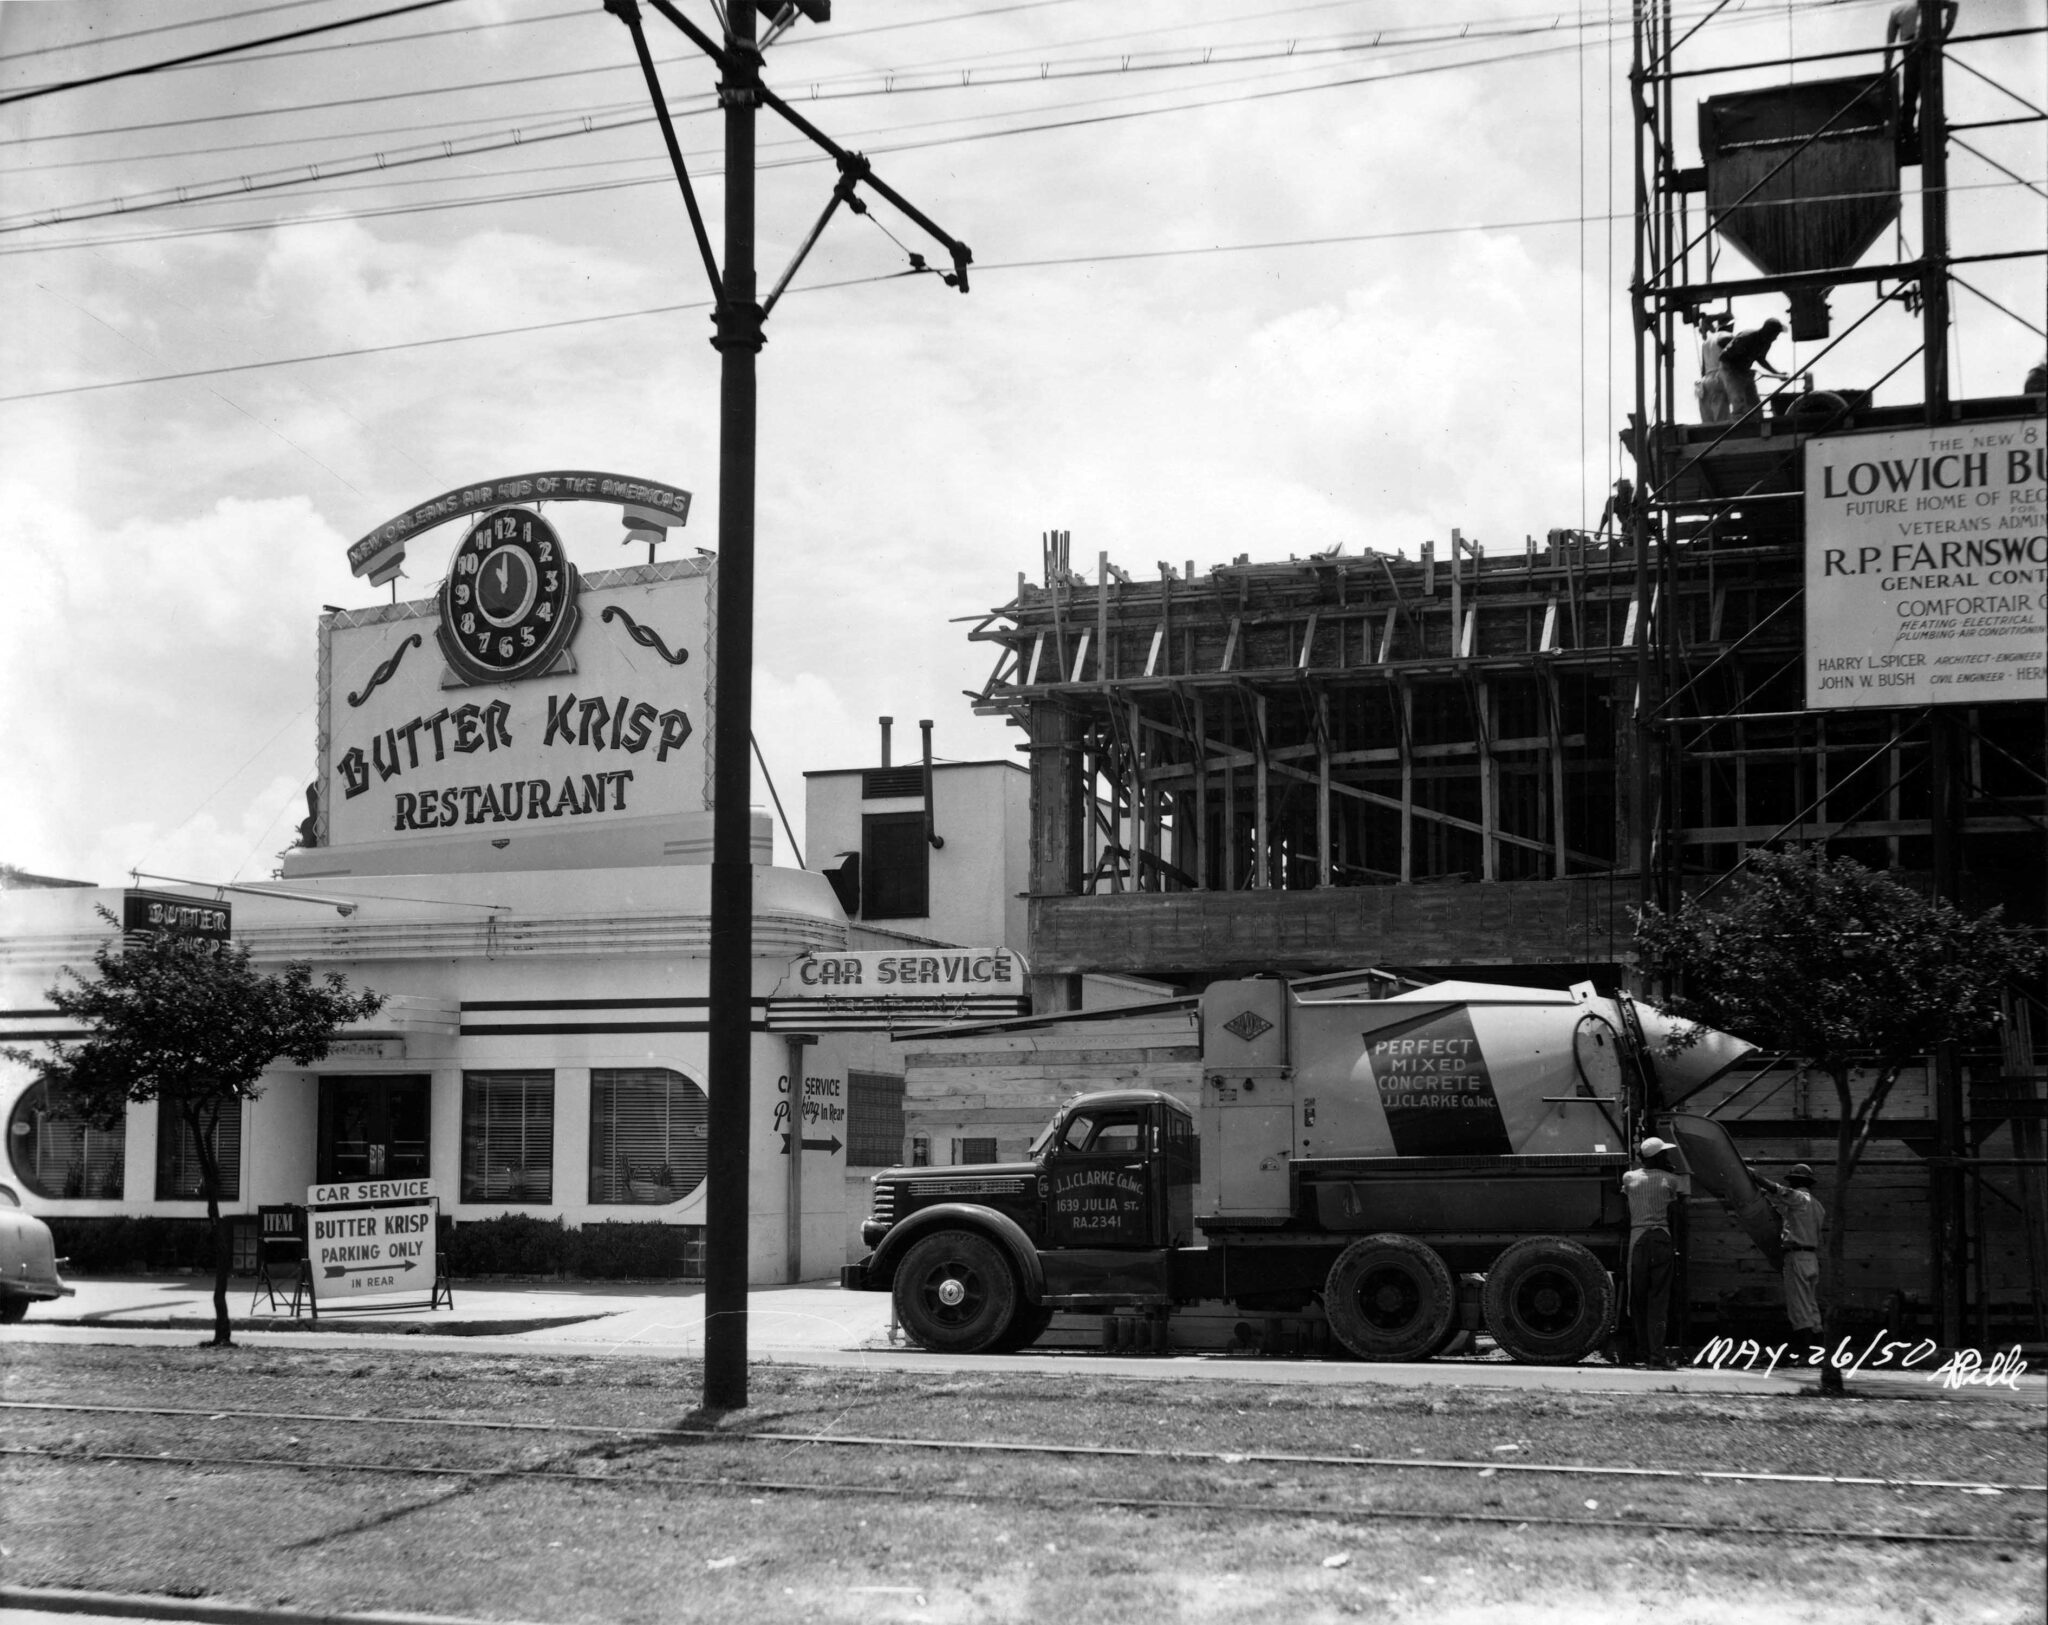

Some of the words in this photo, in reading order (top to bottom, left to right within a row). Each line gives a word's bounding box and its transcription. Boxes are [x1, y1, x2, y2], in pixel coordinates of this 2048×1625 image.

[1929, 438, 1964, 452] THE
[1973, 433, 2014, 449] NEW
[2023, 426, 2039, 444] 8
[1823, 451, 1989, 499] LOWICH
[1846, 497, 1908, 517] FUTURE
[1916, 493, 1967, 512] HOME
[1975, 490, 2000, 507] OF
[350, 532, 382, 564] NEW
[385, 495, 459, 543] ORLEANS
[463, 486, 493, 507] AIR
[536, 477, 560, 493] OF
[564, 477, 597, 493] THE
[601, 478, 686, 513] AMERICAS
[494, 516, 517, 540] 12
[1898, 516, 1991, 536] VETERANS
[475, 528, 492, 550] 11
[523, 521, 532, 543] 1
[537, 541, 553, 563] 2
[1824, 546, 1882, 577] R.P.
[457, 552, 479, 575] 10
[544, 570, 559, 592] 3
[1881, 572, 1979, 592] GENERAL
[1988, 568, 2047, 586] CONT
[455, 584, 470, 605] 9
[1896, 593, 2033, 618] COMFORTAIR
[535, 601, 554, 622] 4
[1962, 614, 2036, 628] ELECTRICAL
[460, 612, 476, 634] 8
[477, 631, 491, 653] 7
[498, 636, 514, 658] 6
[520, 626, 536, 647] 5
[1818, 656, 1864, 671] HARRY
[1818, 675, 1854, 690] JOHN
[1878, 672, 1915, 687] BUSH
[1956, 671, 2005, 684] ENGINEER
[336, 698, 513, 800] BUTTER
[543, 693, 693, 762] KRISP
[394, 769, 634, 831] RESTAURANT
[147, 903, 227, 931] BUTTER
[800, 958, 863, 985] CAR
[877, 956, 1012, 984] SERVICE
[1375, 1039, 1474, 1055] PERFECT
[1391, 1058, 1466, 1072] MIXED
[805, 1077, 840, 1096] SERVICE
[1378, 1075, 1480, 1090] CONCRETE
[821, 1103, 828, 1120] In
[829, 1103, 845, 1124] Rear
[316, 1186, 349, 1201] CAR
[358, 1181, 428, 1199] SERVICE
[1057, 1199, 1079, 1212] 1639
[1082, 1198, 1118, 1211] JULIA
[263, 1213, 293, 1232] ITEM
[315, 1217, 376, 1239] BUTTER
[385, 1213, 429, 1234] KRISP
[322, 1244, 380, 1263] PARKING
[389, 1241, 423, 1257] ONLY
[352, 1279, 361, 1288] IN
[367, 1276, 394, 1287] REAR
